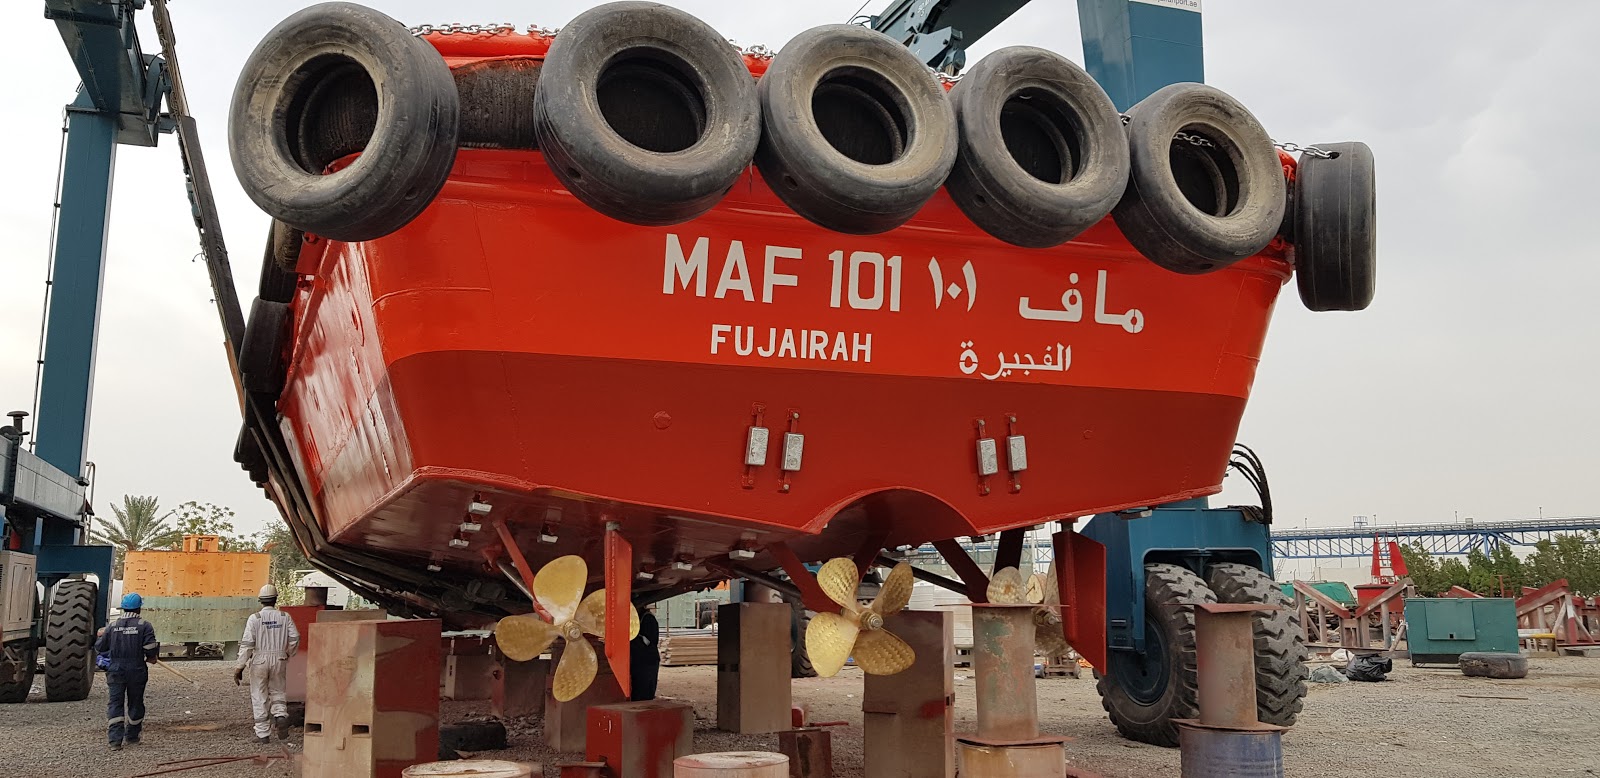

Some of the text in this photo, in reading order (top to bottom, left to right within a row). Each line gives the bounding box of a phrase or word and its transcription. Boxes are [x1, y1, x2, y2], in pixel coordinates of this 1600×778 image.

[662, 233, 902, 312] MAF 101
[928, 256, 1145, 334] ماف ١٠١
[710, 324, 873, 363] FUJAIRAH
[959, 340, 1072, 380] الفجيرة
